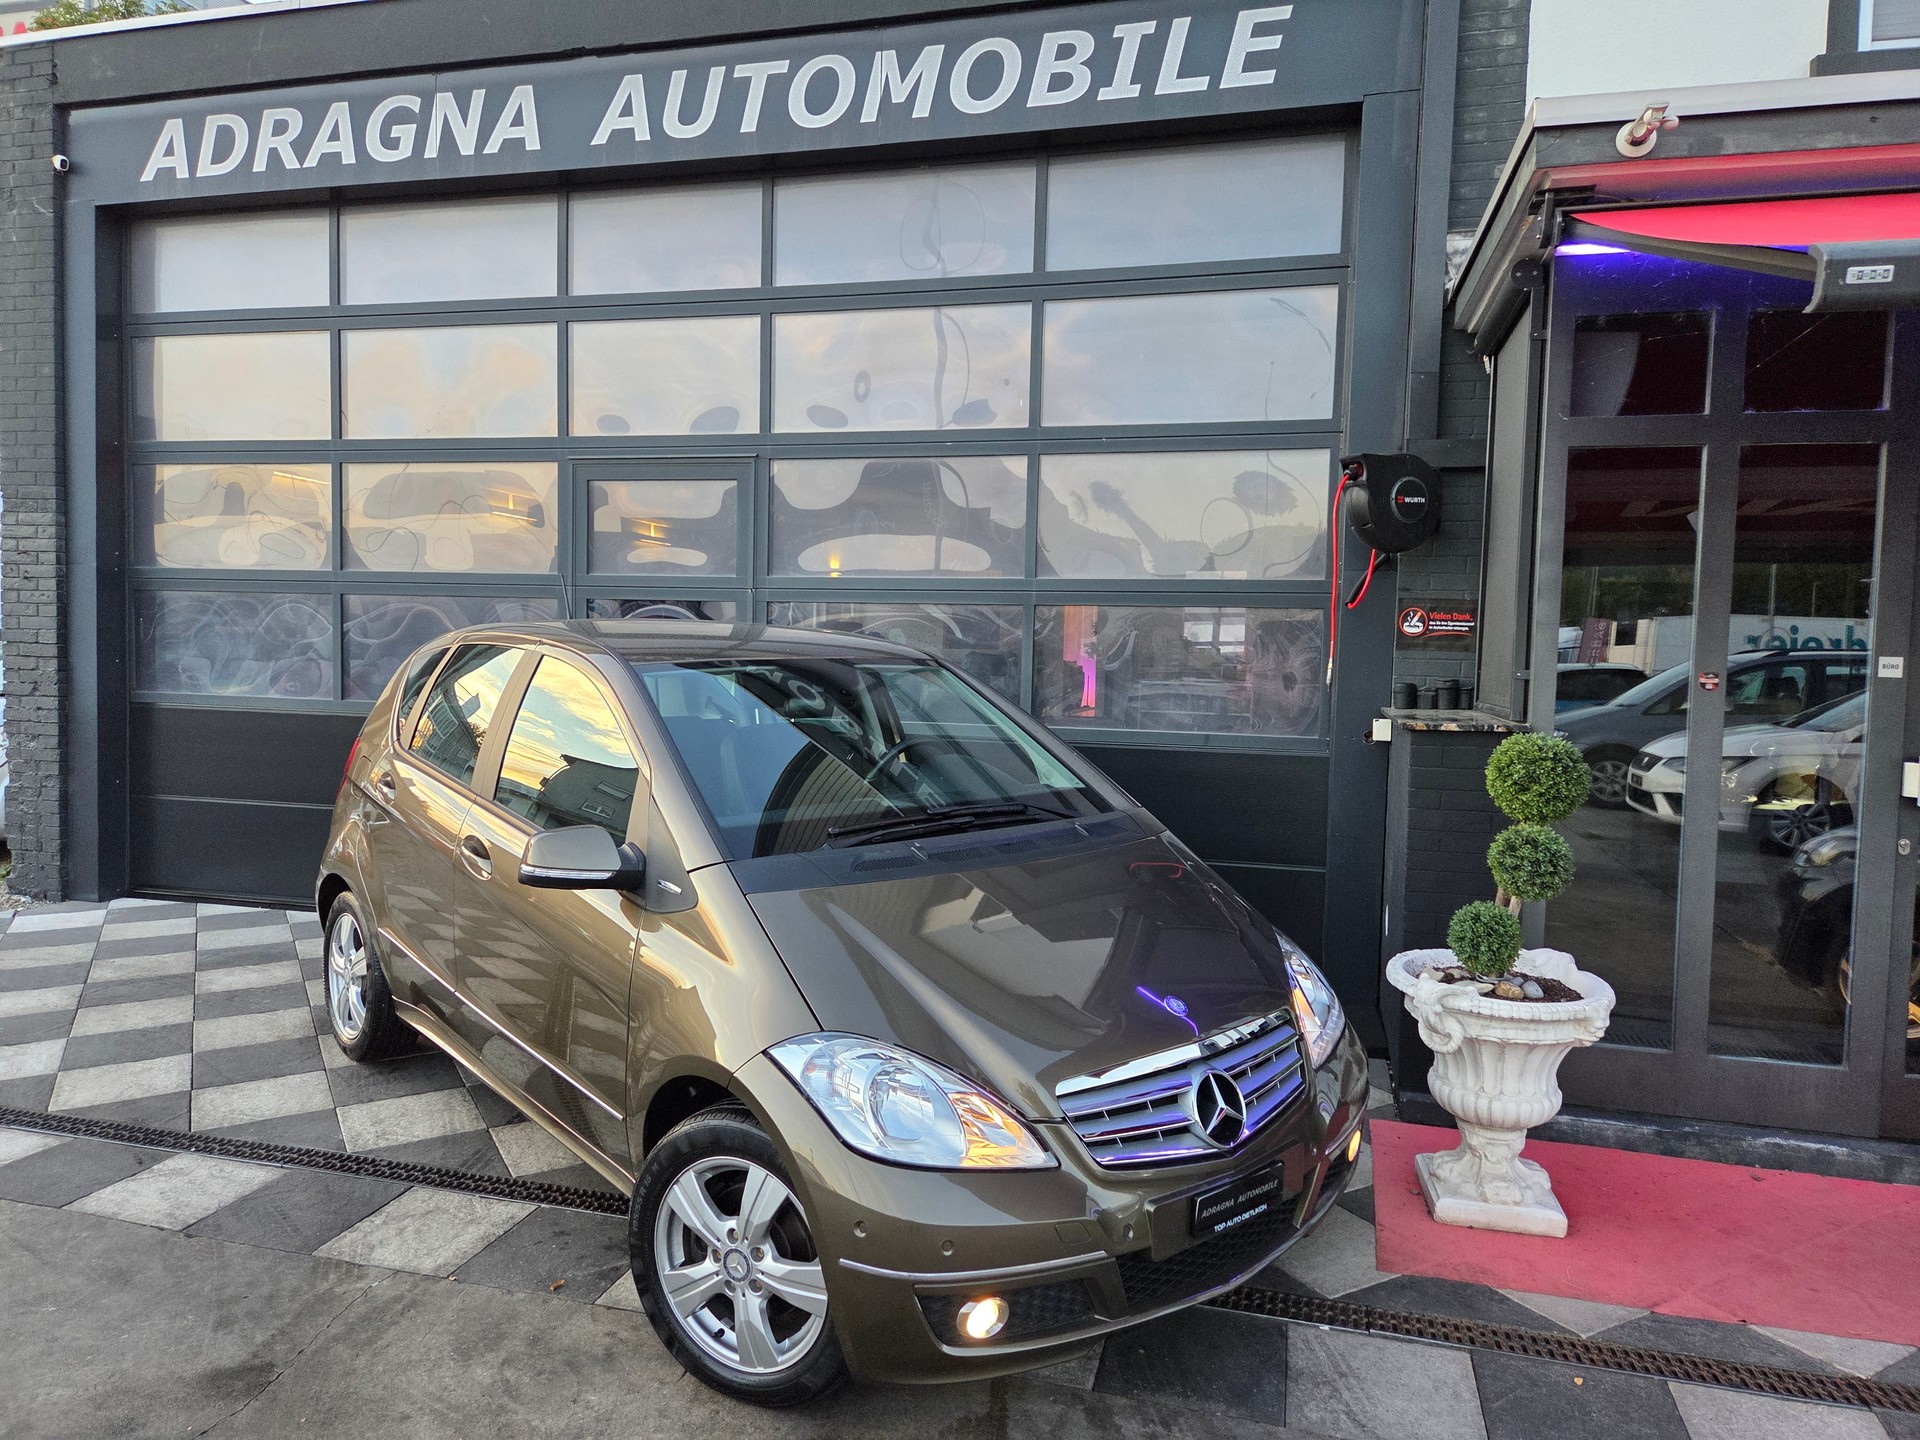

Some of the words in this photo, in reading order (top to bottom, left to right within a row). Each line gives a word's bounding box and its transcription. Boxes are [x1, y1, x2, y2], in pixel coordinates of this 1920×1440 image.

[139, 84, 542, 183] ADRAGNA
[590, 3, 1295, 146] AUTOMOBILE
[1429, 612, 1452, 620] Vielen
[1882, 662, 1899, 670] BÜRO
[1202, 1199, 1234, 1218] ADRAGNA
[1237, 1180, 1278, 1203] AUTOMOBILE
[1214, 1224, 1226, 1232] TOP
[1227, 1216, 1242, 1227] AUTO
